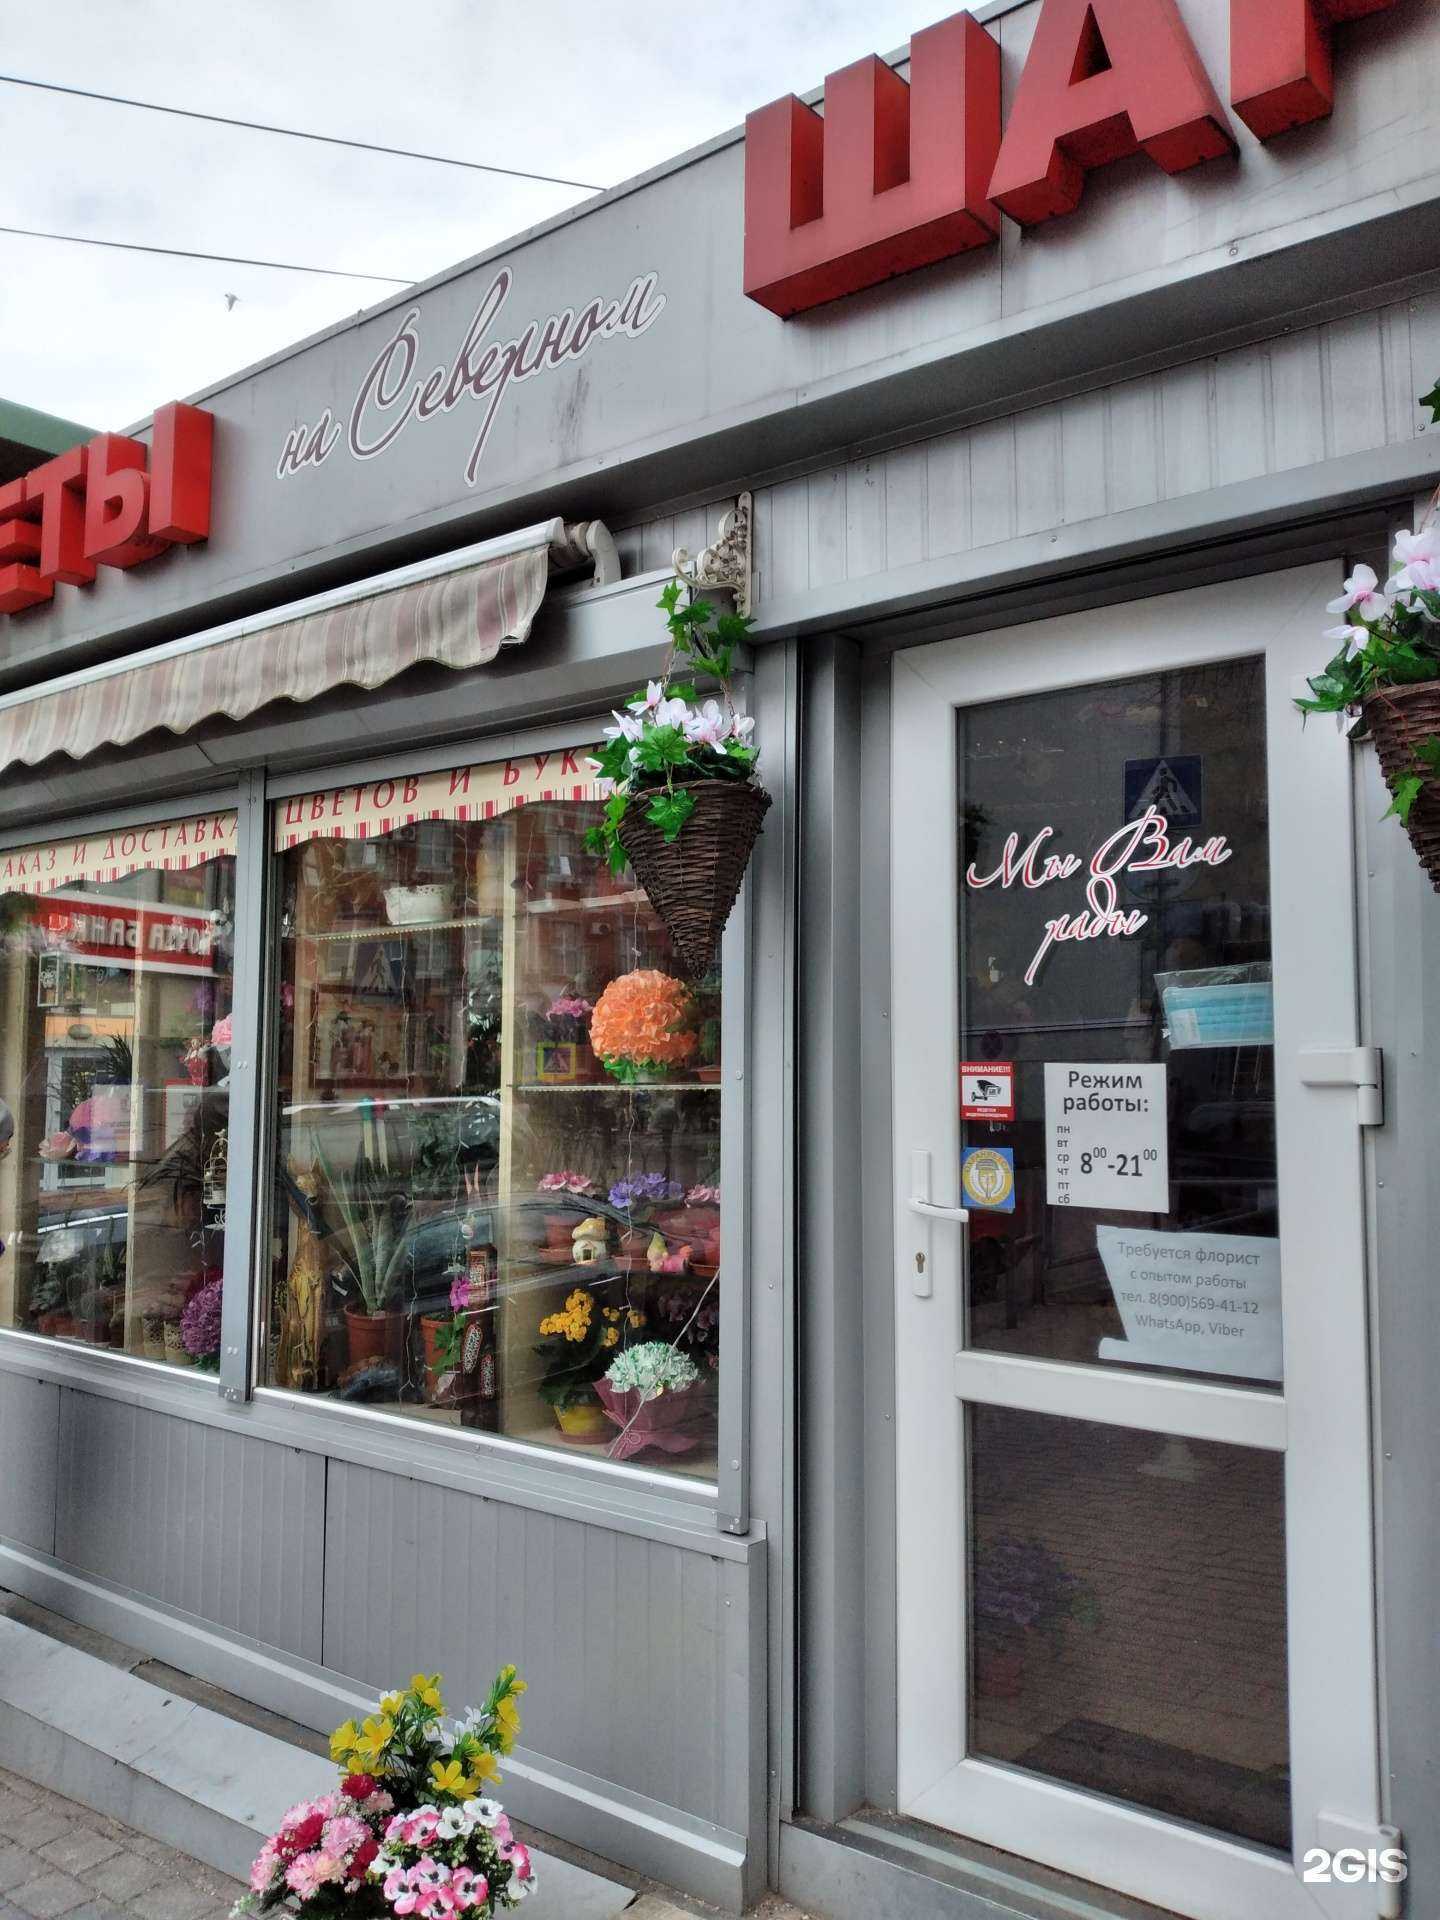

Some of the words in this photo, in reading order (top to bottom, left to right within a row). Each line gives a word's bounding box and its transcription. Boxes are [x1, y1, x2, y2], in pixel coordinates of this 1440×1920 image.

[276, 408, 343, 479] на
[348, 265, 667, 487] Северном
[284, 775, 420, 825] ЦВЕТОВ
[448, 766, 472, 797] И
[967, 827, 1082, 889] Мы
[1089, 804, 1233, 878] Вам
[0, 849, 57, 879] АКАЗ
[72, 843, 88, 866] И
[1024, 875, 1149, 986] рады
[1068, 1070, 1143, 1089] Режим
[1063, 1092, 1149, 1115] работы:
[1056, 1125, 1071, 1134] пн
[1056, 1139, 1069, 1148] вт
[1057, 1153, 1070, 1164] ср
[1057, 1167, 1070, 1176] чт
[1057, 1181, 1070, 1190] пт
[1057, 1193, 1071, 1204] сб
[1117, 1241, 1191, 1260] Требуется
[1194, 1247, 1261, 1266] флорист
[1130, 1269, 1137, 1280] с
[1139, 1270, 1192, 1285] опытом
[1196, 1276, 1248, 1290] работы
[1121, 1290, 1145, 1304] тел.
[1135, 1314, 1206, 1336] WhatsApp,
[1208, 1322, 1245, 1338] Viber
